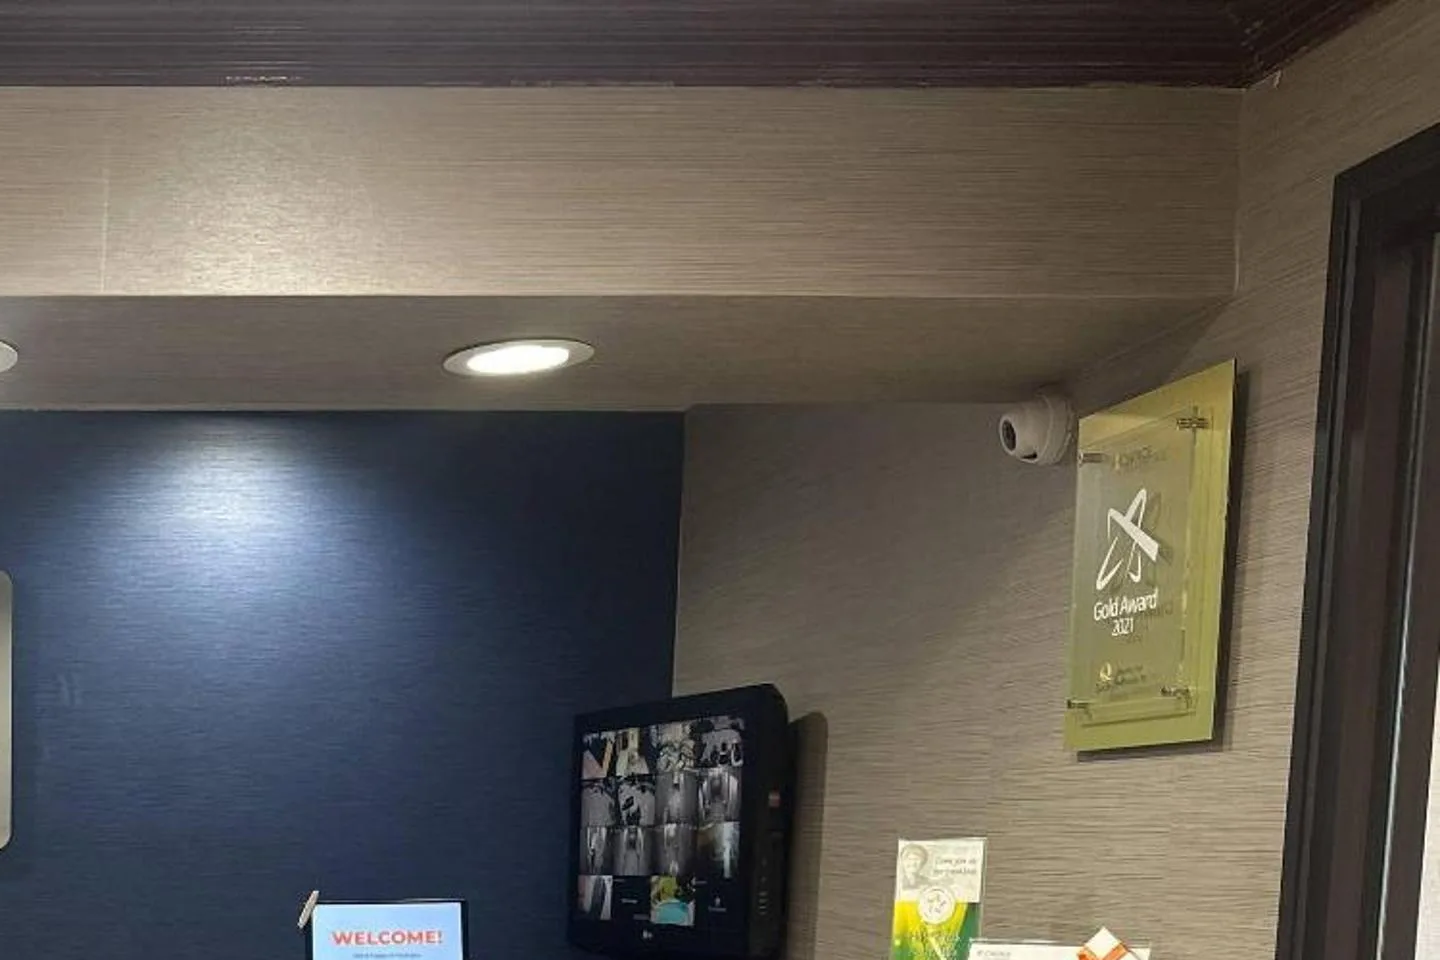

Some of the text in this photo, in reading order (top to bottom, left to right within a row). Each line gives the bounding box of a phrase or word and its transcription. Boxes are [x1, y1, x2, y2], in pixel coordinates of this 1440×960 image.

[1094, 586, 1159, 621] Gold Award
[1111, 617, 1134, 637] 2021
[332, 930, 443, 946] WELCOME!
